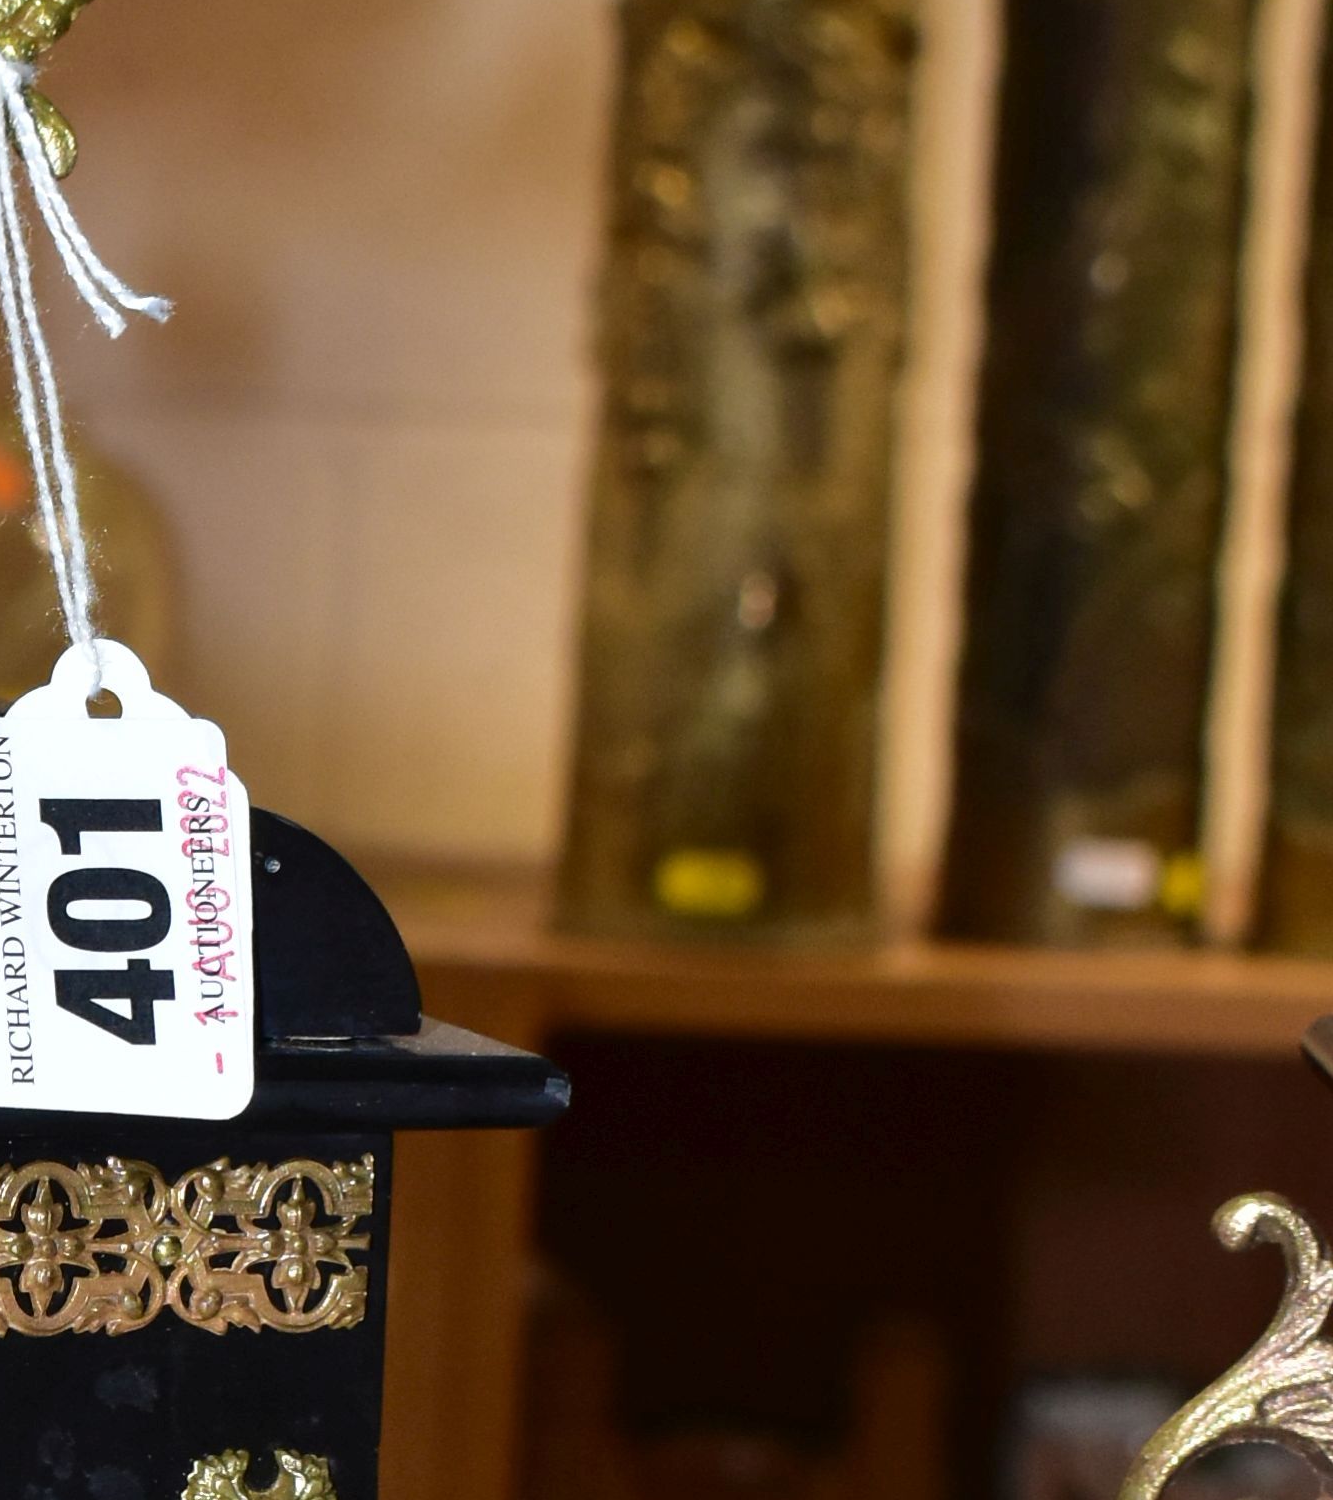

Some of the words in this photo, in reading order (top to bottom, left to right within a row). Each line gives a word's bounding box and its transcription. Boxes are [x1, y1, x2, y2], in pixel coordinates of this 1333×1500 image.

[176, 765, 231, 858] 2022
[38, 797, 176, 1046] 401
[186, 886, 237, 982] AUG
[187, 795, 225, 1024] AUCTIONEERS
[2, 936, 35, 1085] RICHARD
